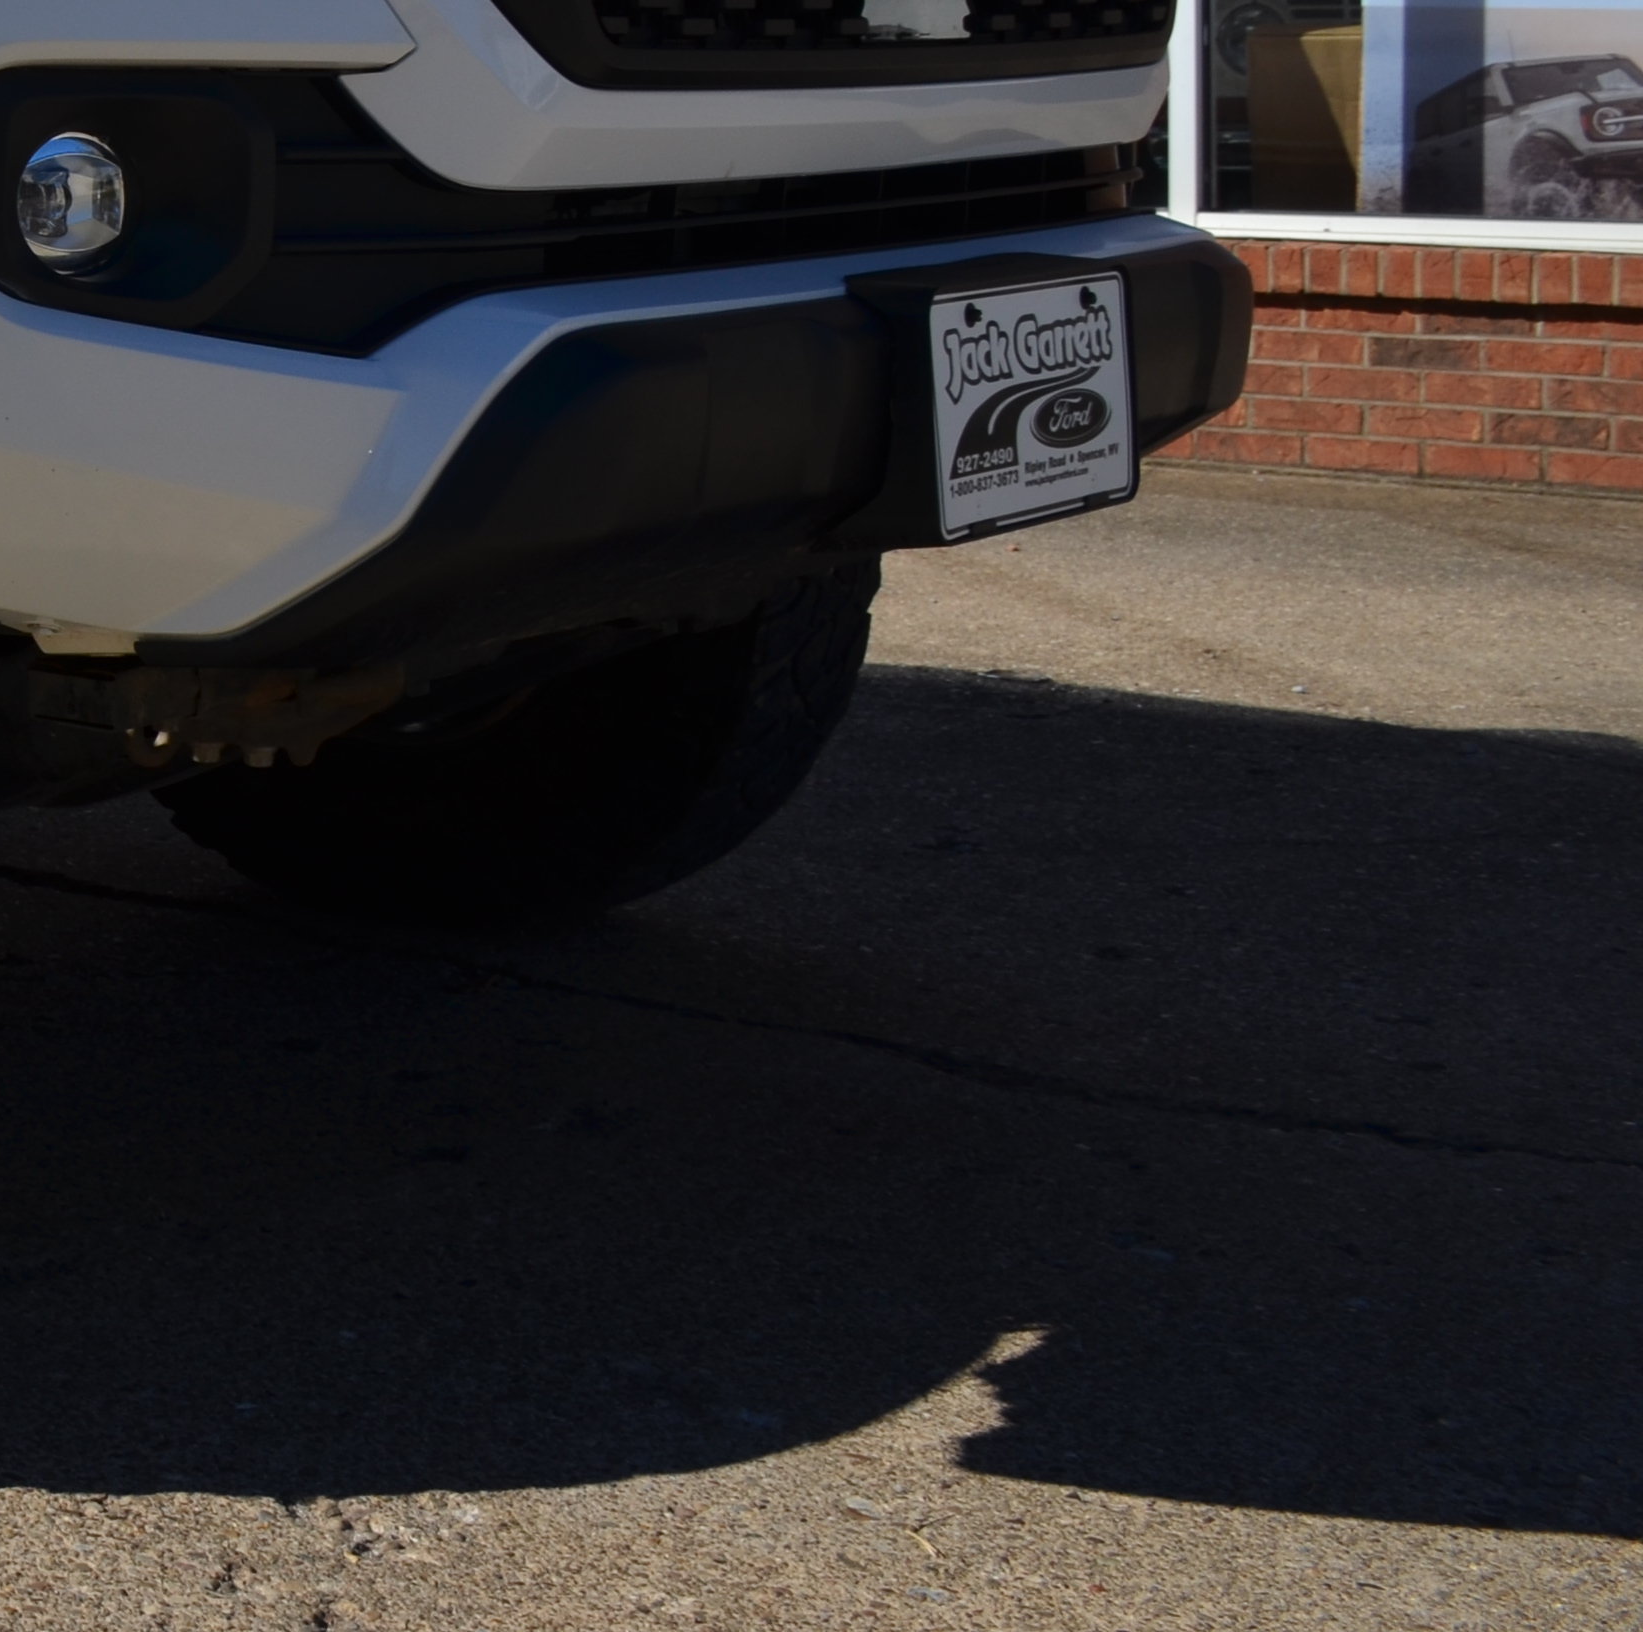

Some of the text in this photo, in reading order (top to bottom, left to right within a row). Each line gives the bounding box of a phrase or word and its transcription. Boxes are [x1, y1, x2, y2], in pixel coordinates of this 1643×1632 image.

[943, 304, 1113, 406] Jack Garrett
[1048, 394, 1095, 434] Ford
[956, 446, 1014, 474] 927-2490
